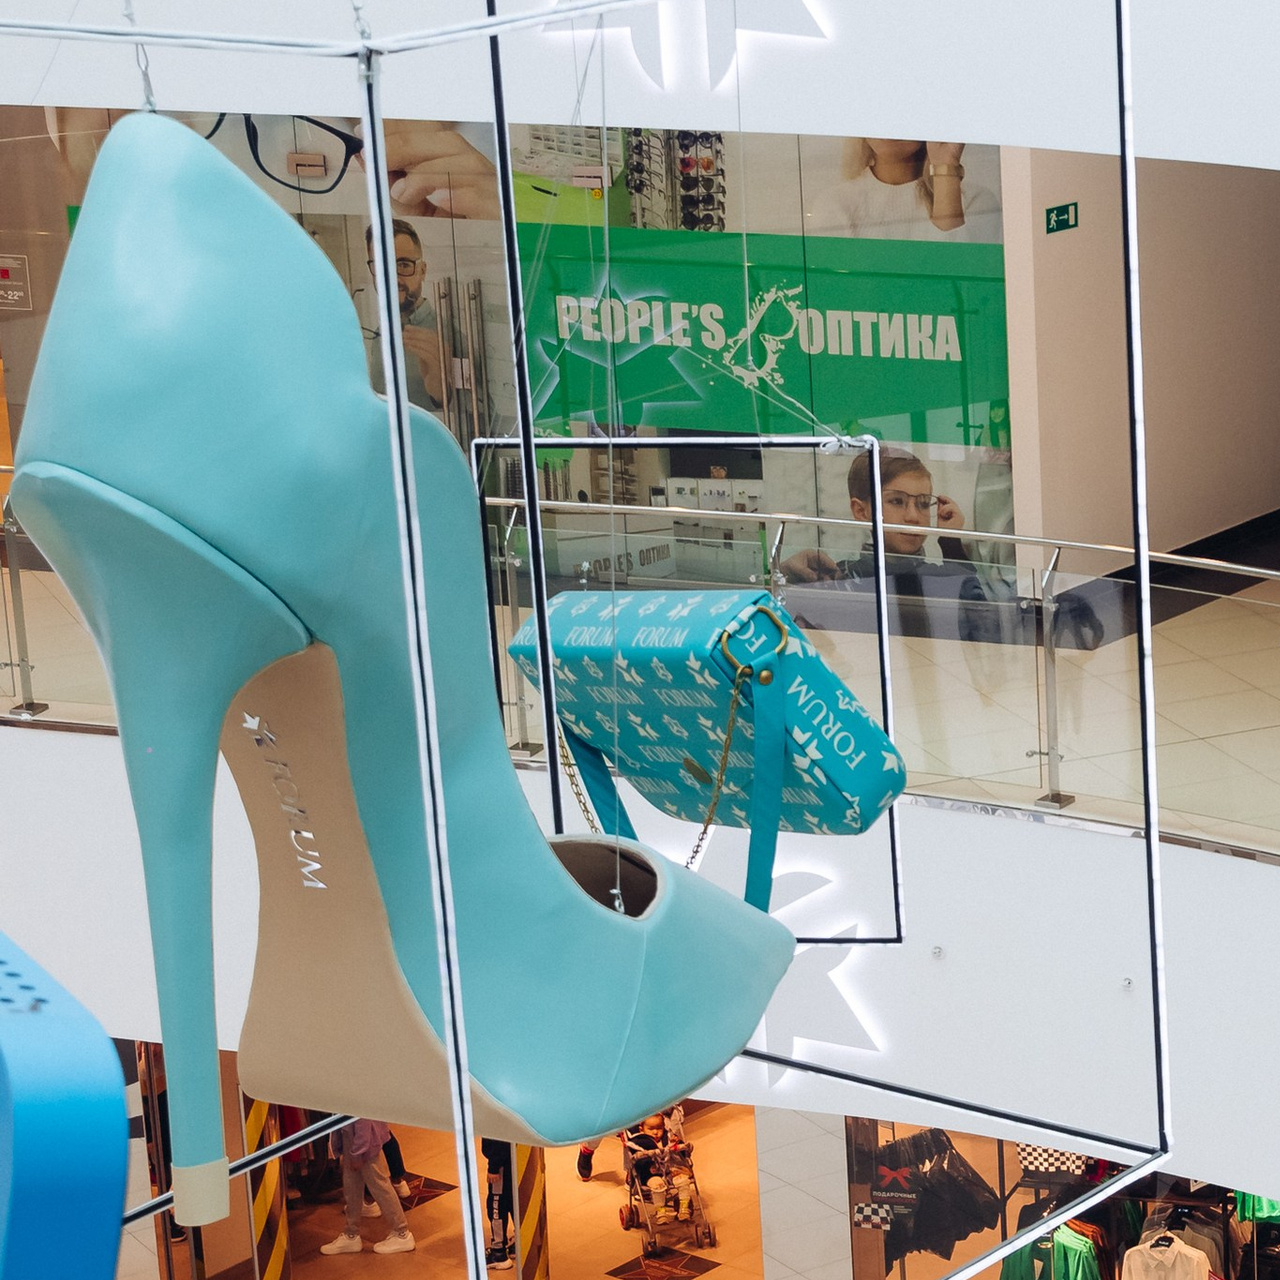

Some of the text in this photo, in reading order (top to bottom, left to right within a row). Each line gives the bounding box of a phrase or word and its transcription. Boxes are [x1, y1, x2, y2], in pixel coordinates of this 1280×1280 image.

[556, 295, 963, 362] PEOPLE'S ОПТИКА
[639, 543, 671, 567] ОПТИКА
[563, 626, 619, 647] FORUM
[631, 627, 689, 648] FORUM
[586, 685, 645, 706] FORUM
[652, 688, 718, 708] FORUM
[786, 674, 867, 771] FORUM
[264, 757, 328, 889] FORUM
[872, 1190, 917, 1199] ПОДАРОЧНЫЕ
